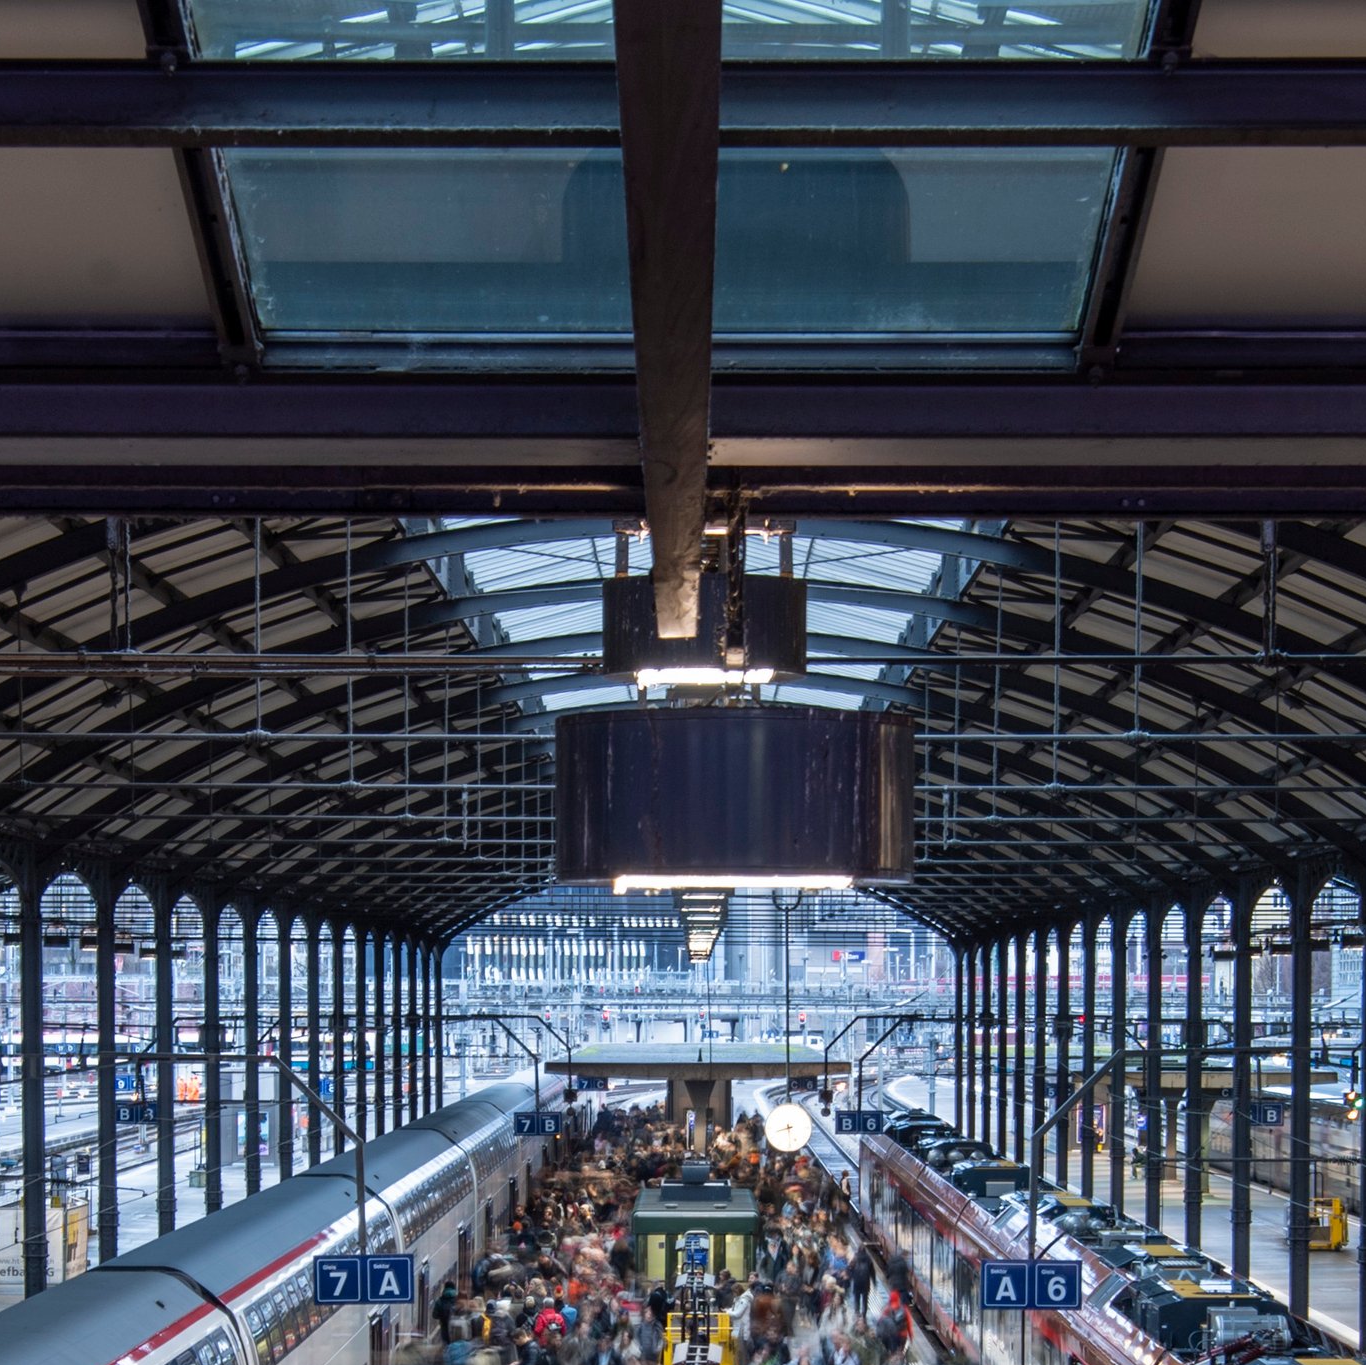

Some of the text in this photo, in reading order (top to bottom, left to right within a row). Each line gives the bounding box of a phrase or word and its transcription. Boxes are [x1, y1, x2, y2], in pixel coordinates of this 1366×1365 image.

[117, 1080, 125, 1088] 9
[791, 1080, 813, 1088] C 6
[1048, 1088, 1055, 1096] 5
[1221, 1088, 1229, 1097] C
[120, 1108, 130, 1120] B
[1267, 1110, 1277, 1122] B
[521, 1120, 555, 1132] 7 B
[842, 1120, 876, 1131] B 6
[329, 1270, 401, 1296] 7 A
[995, 1276, 1067, 1301] A 6
